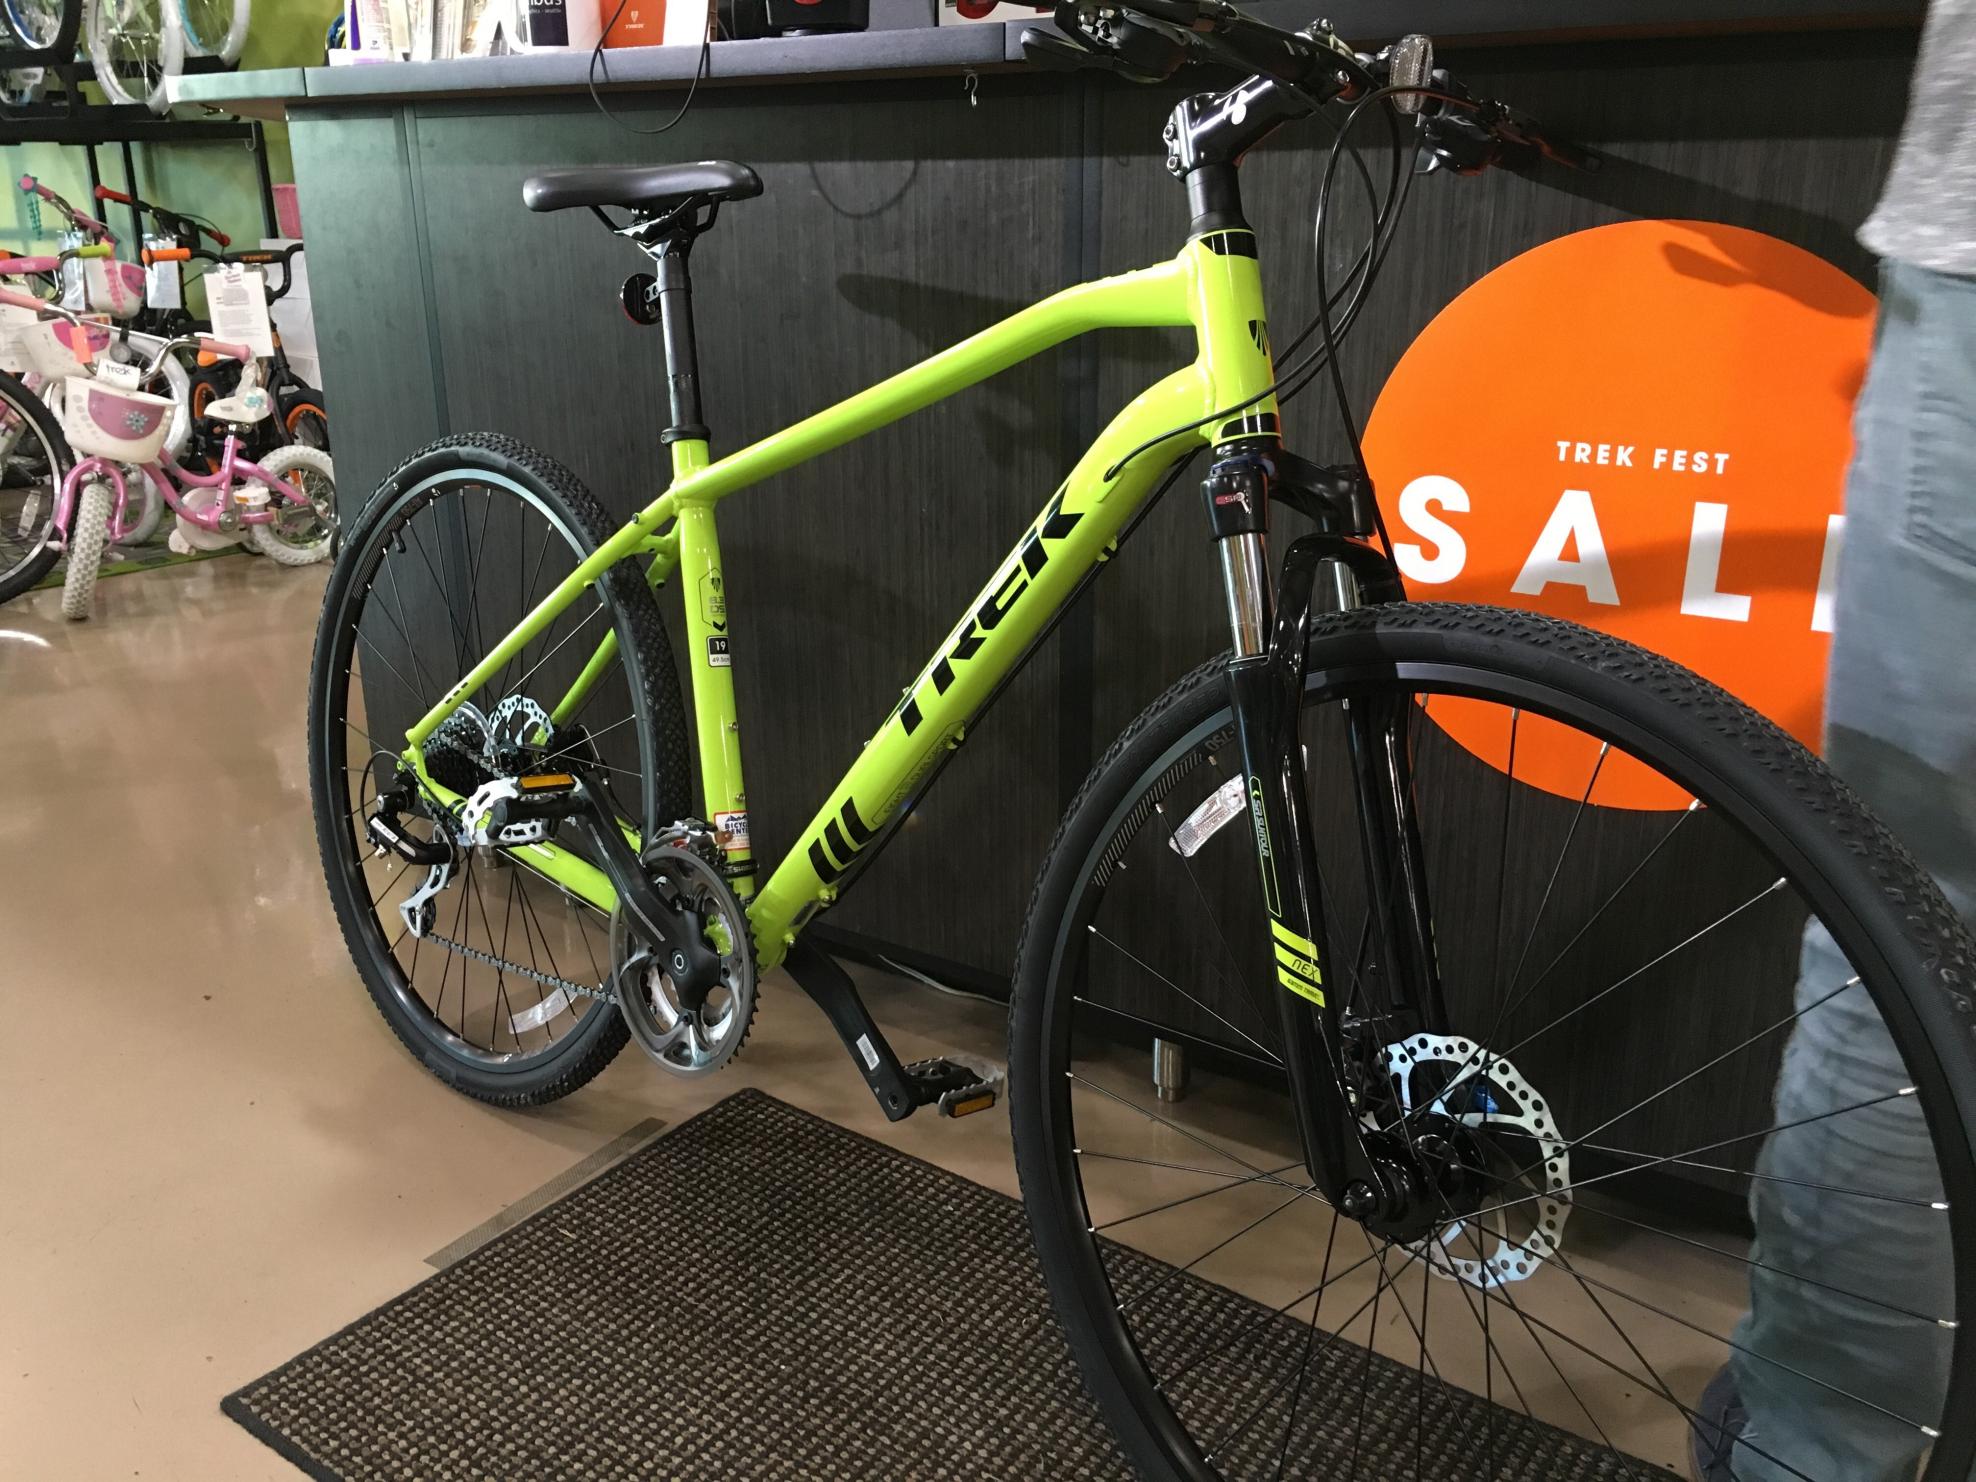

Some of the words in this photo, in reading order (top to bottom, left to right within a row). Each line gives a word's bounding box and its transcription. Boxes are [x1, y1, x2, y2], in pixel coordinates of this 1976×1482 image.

[1557, 441, 1635, 467] TREK
[1653, 448, 1730, 474] FEST
[885, 480, 1085, 737] TREK
[714, 640, 726, 651] 19
[1256, 817, 1270, 858] SUNTOUR
